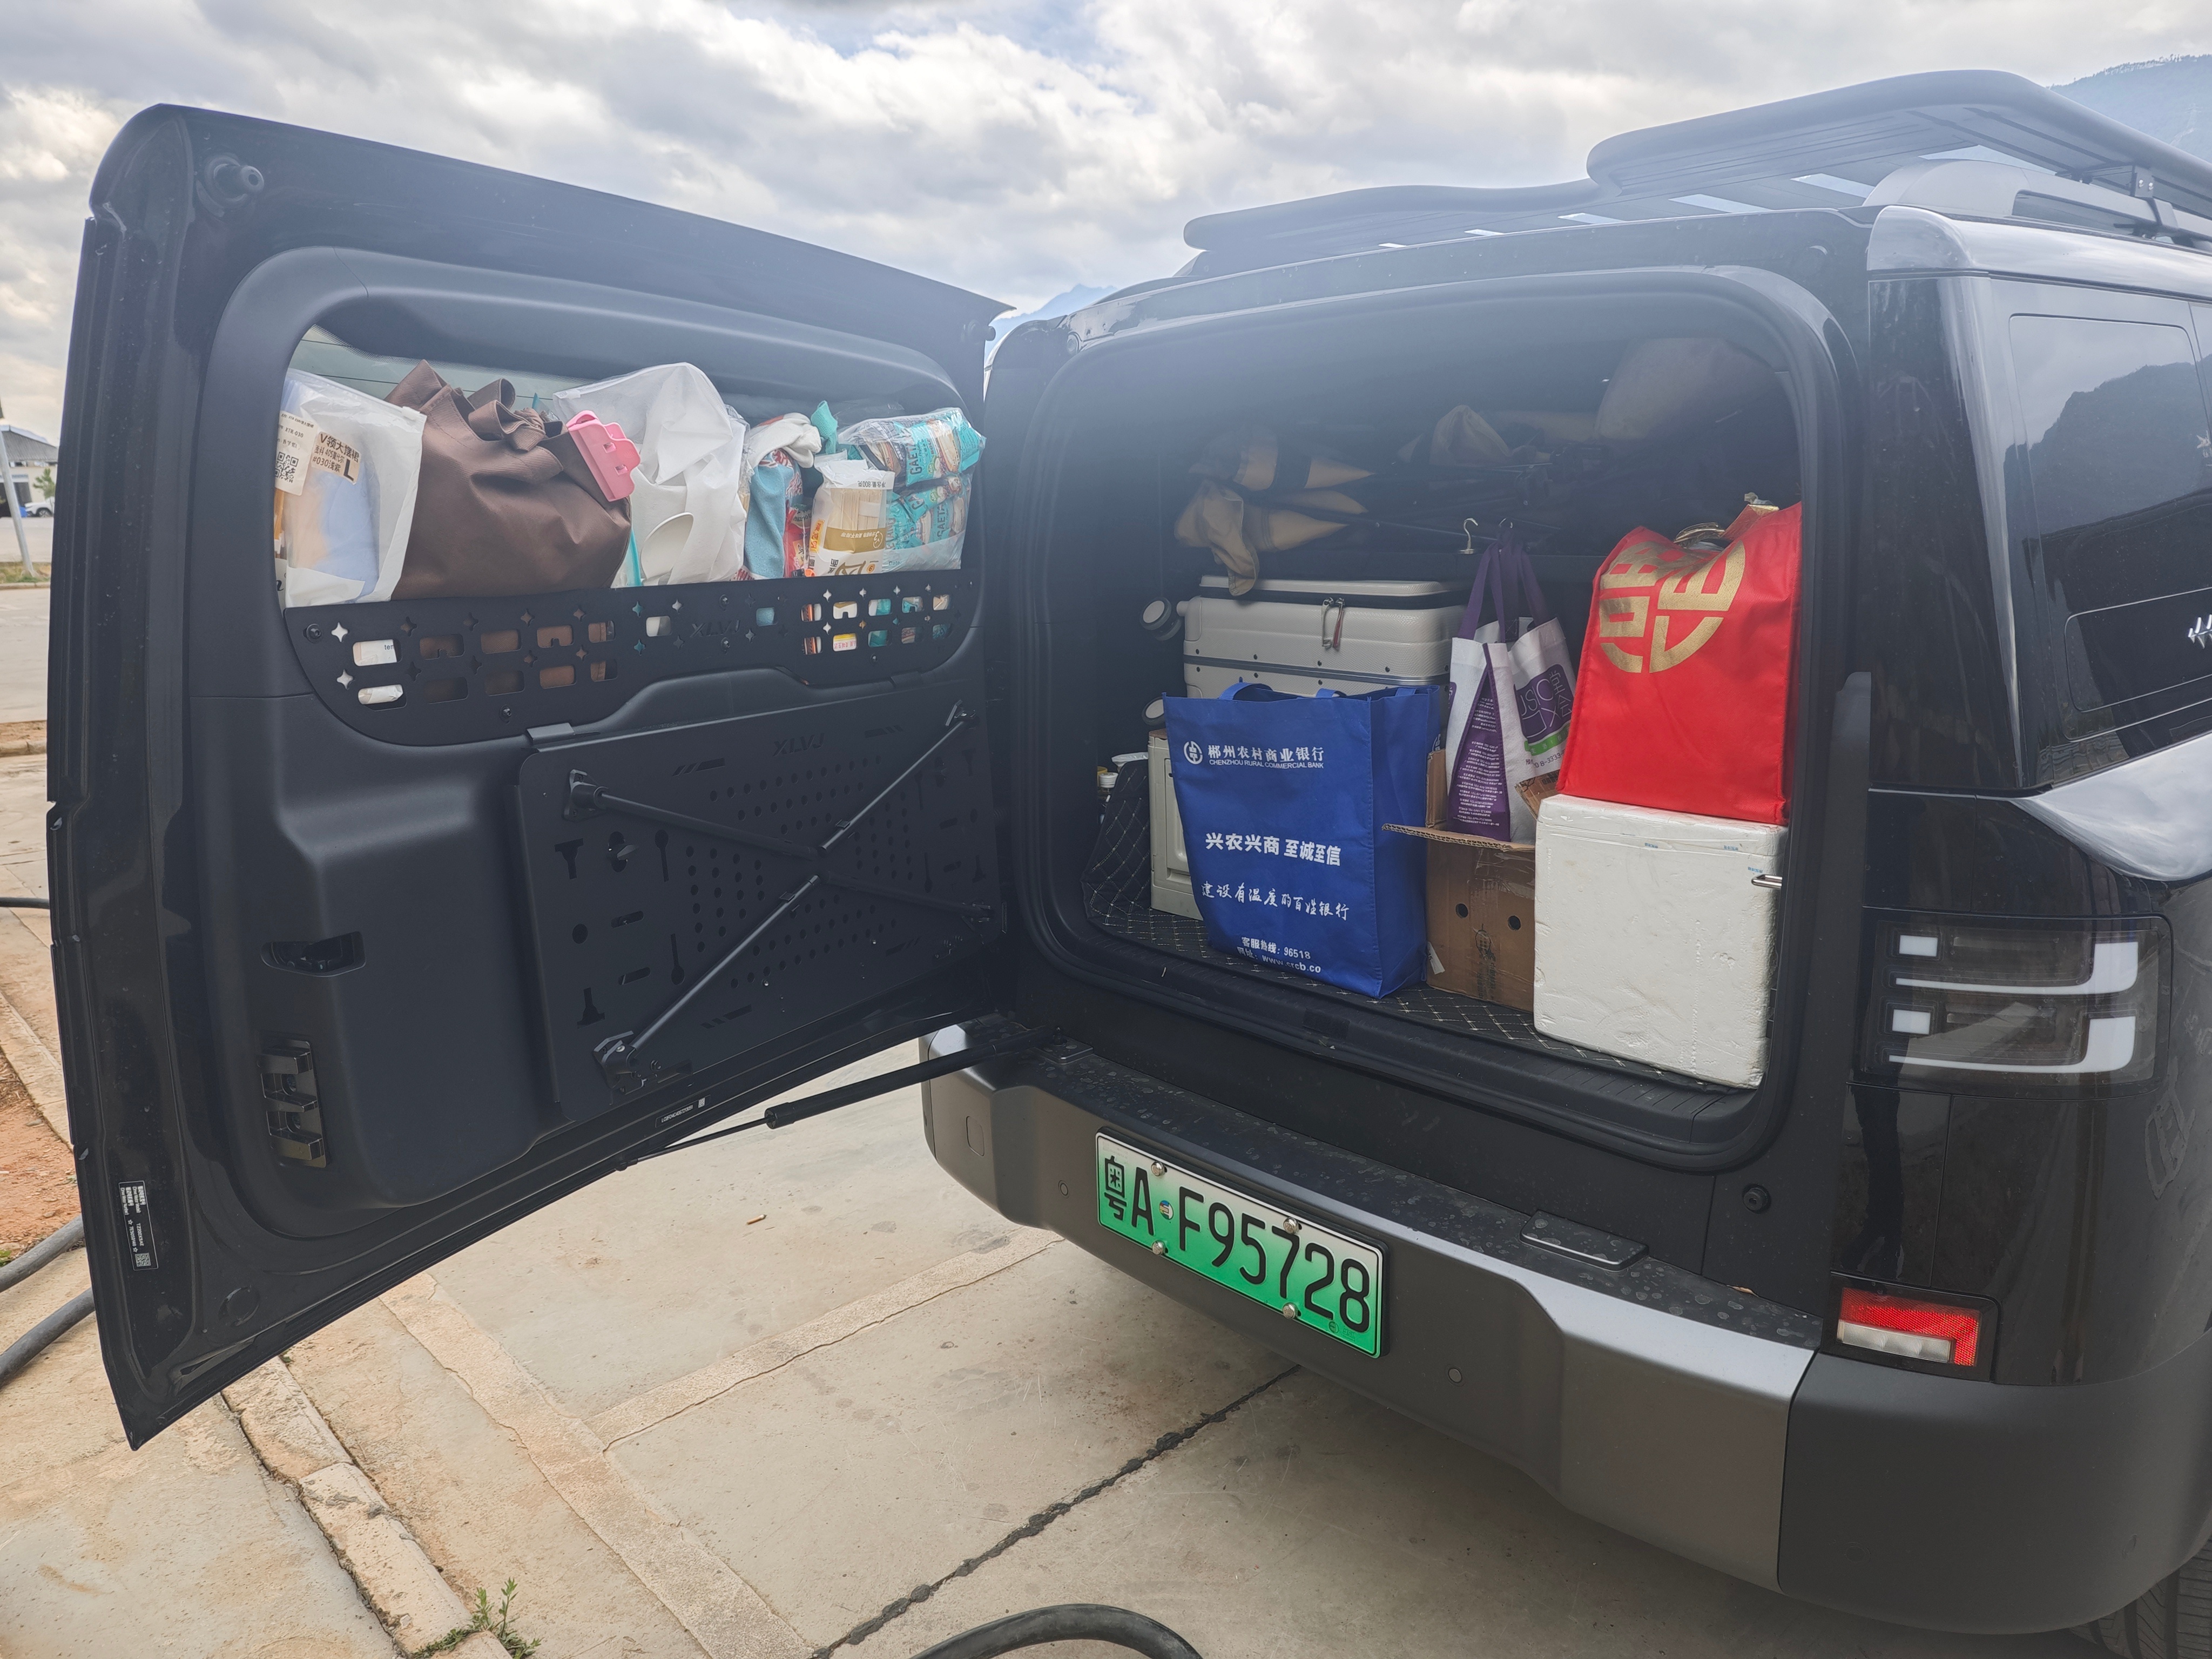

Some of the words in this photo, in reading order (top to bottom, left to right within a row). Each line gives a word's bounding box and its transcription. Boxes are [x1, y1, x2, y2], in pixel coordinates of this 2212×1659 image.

[320, 433, 359, 463] V领大摆裙
[343, 458, 354, 481] L
[1208, 745, 1324, 763] 郴州农村商业银行
[1205, 832, 1280, 855] 兴农兴商
[1284, 839, 1341, 866] 至诚至信
[1201, 880, 1350, 921] 建设有温度的百姓银行
[1284, 947, 1311, 960] 96518
